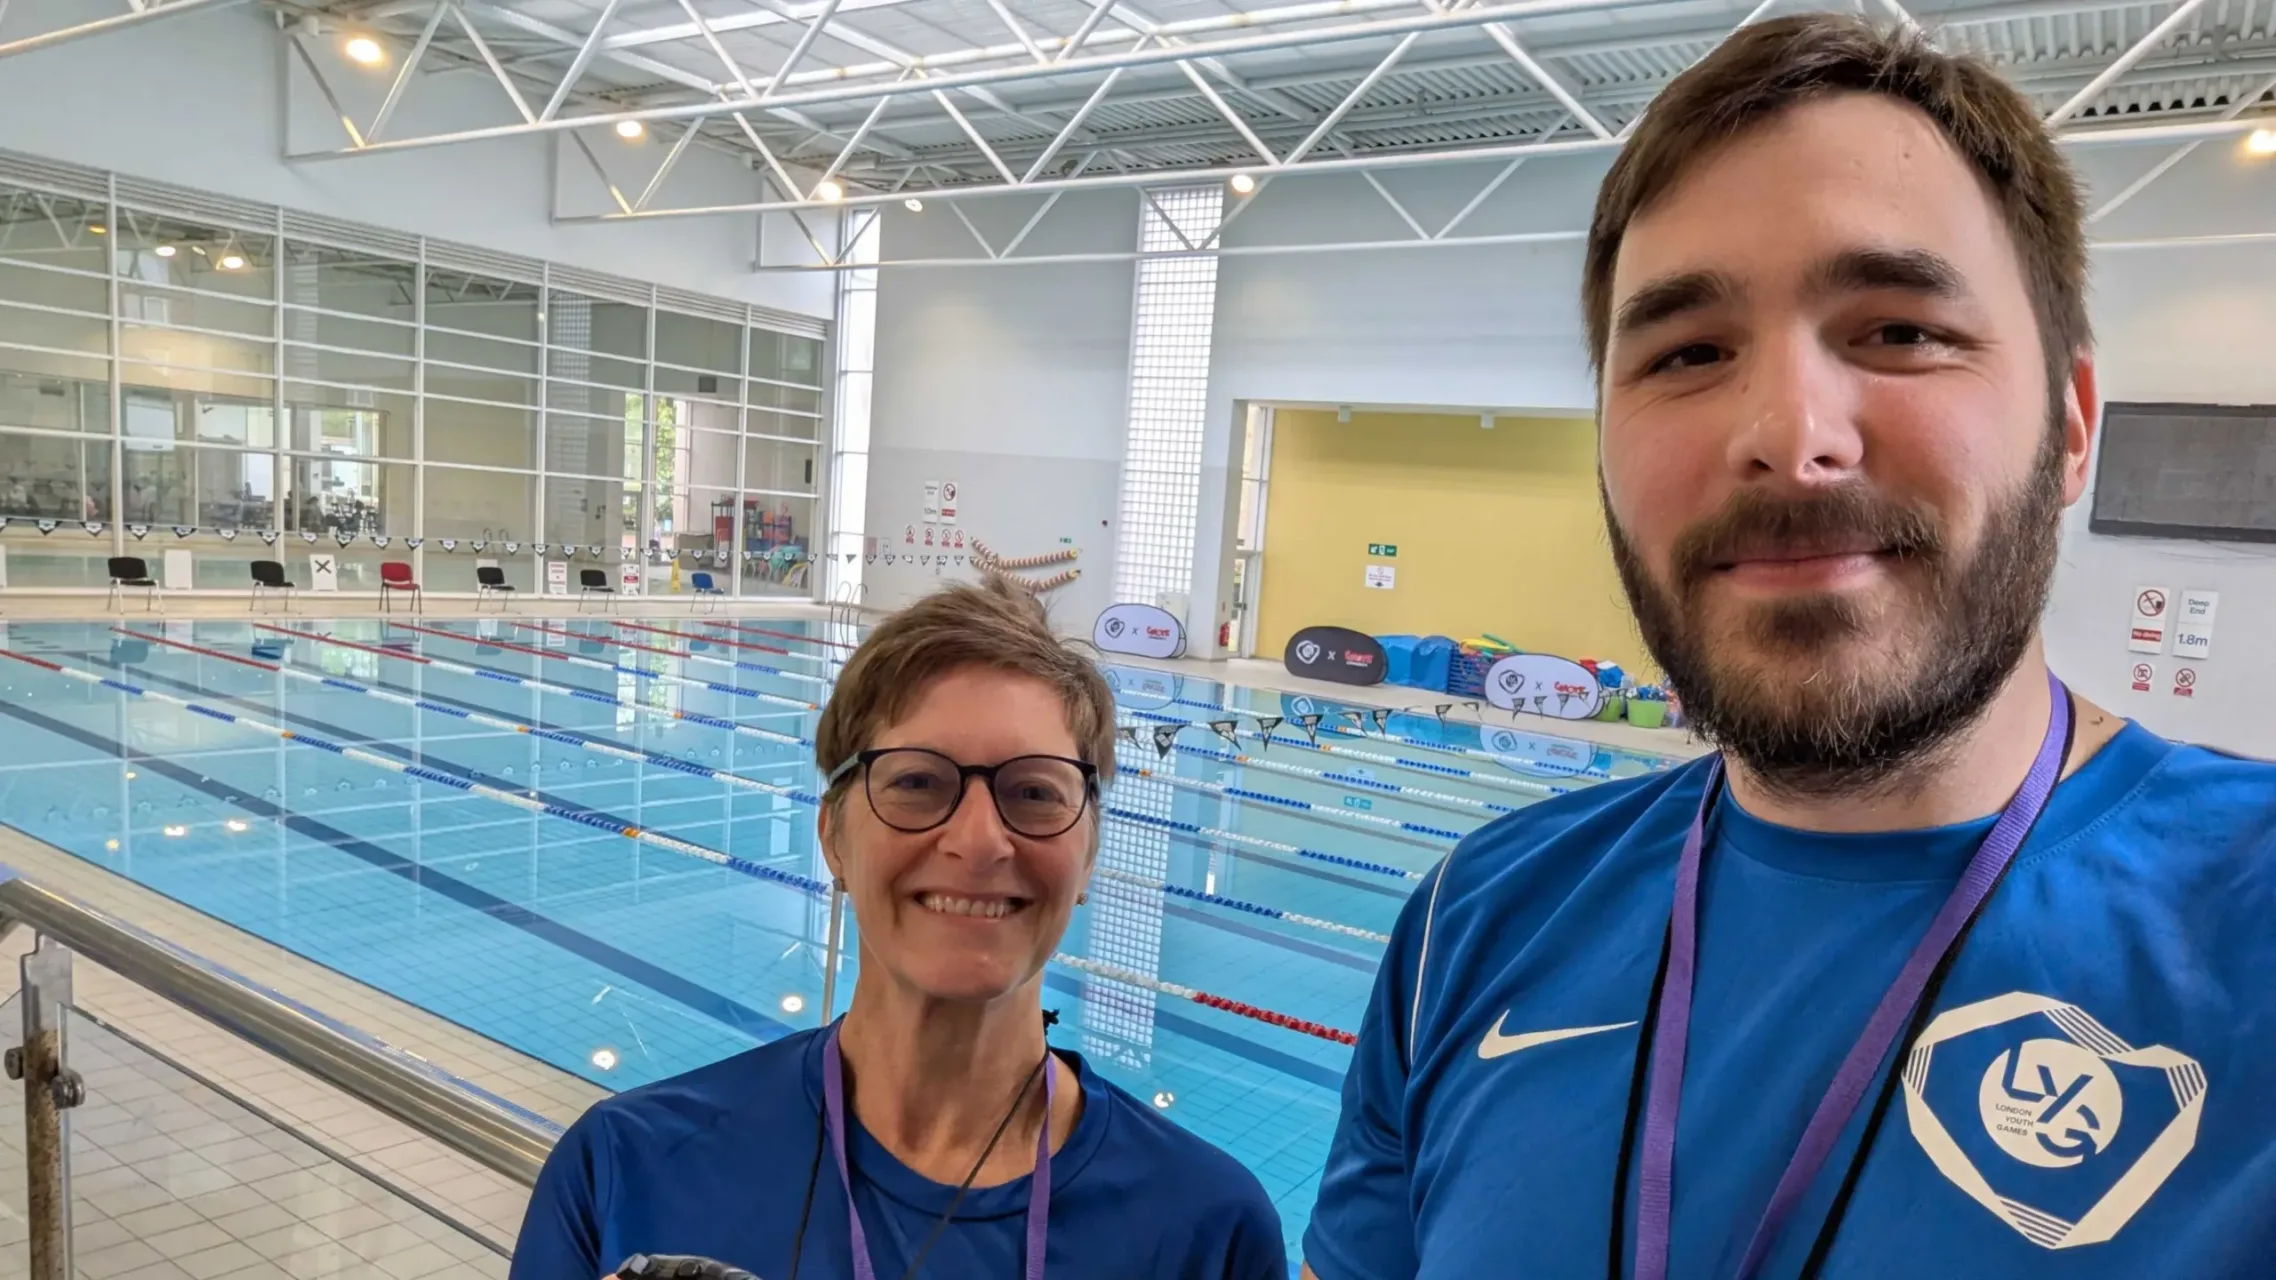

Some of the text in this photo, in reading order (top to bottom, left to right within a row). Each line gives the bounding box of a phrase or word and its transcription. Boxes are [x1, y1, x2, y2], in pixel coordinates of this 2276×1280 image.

[2188, 599, 2209, 607] Deep
[2178, 633, 2208, 646] 1.8m
[1995, 1103, 2032, 1117] LONDON
[2005, 1115, 2034, 1127] YOUTH
[1996, 1123, 2028, 1136] GAMES
